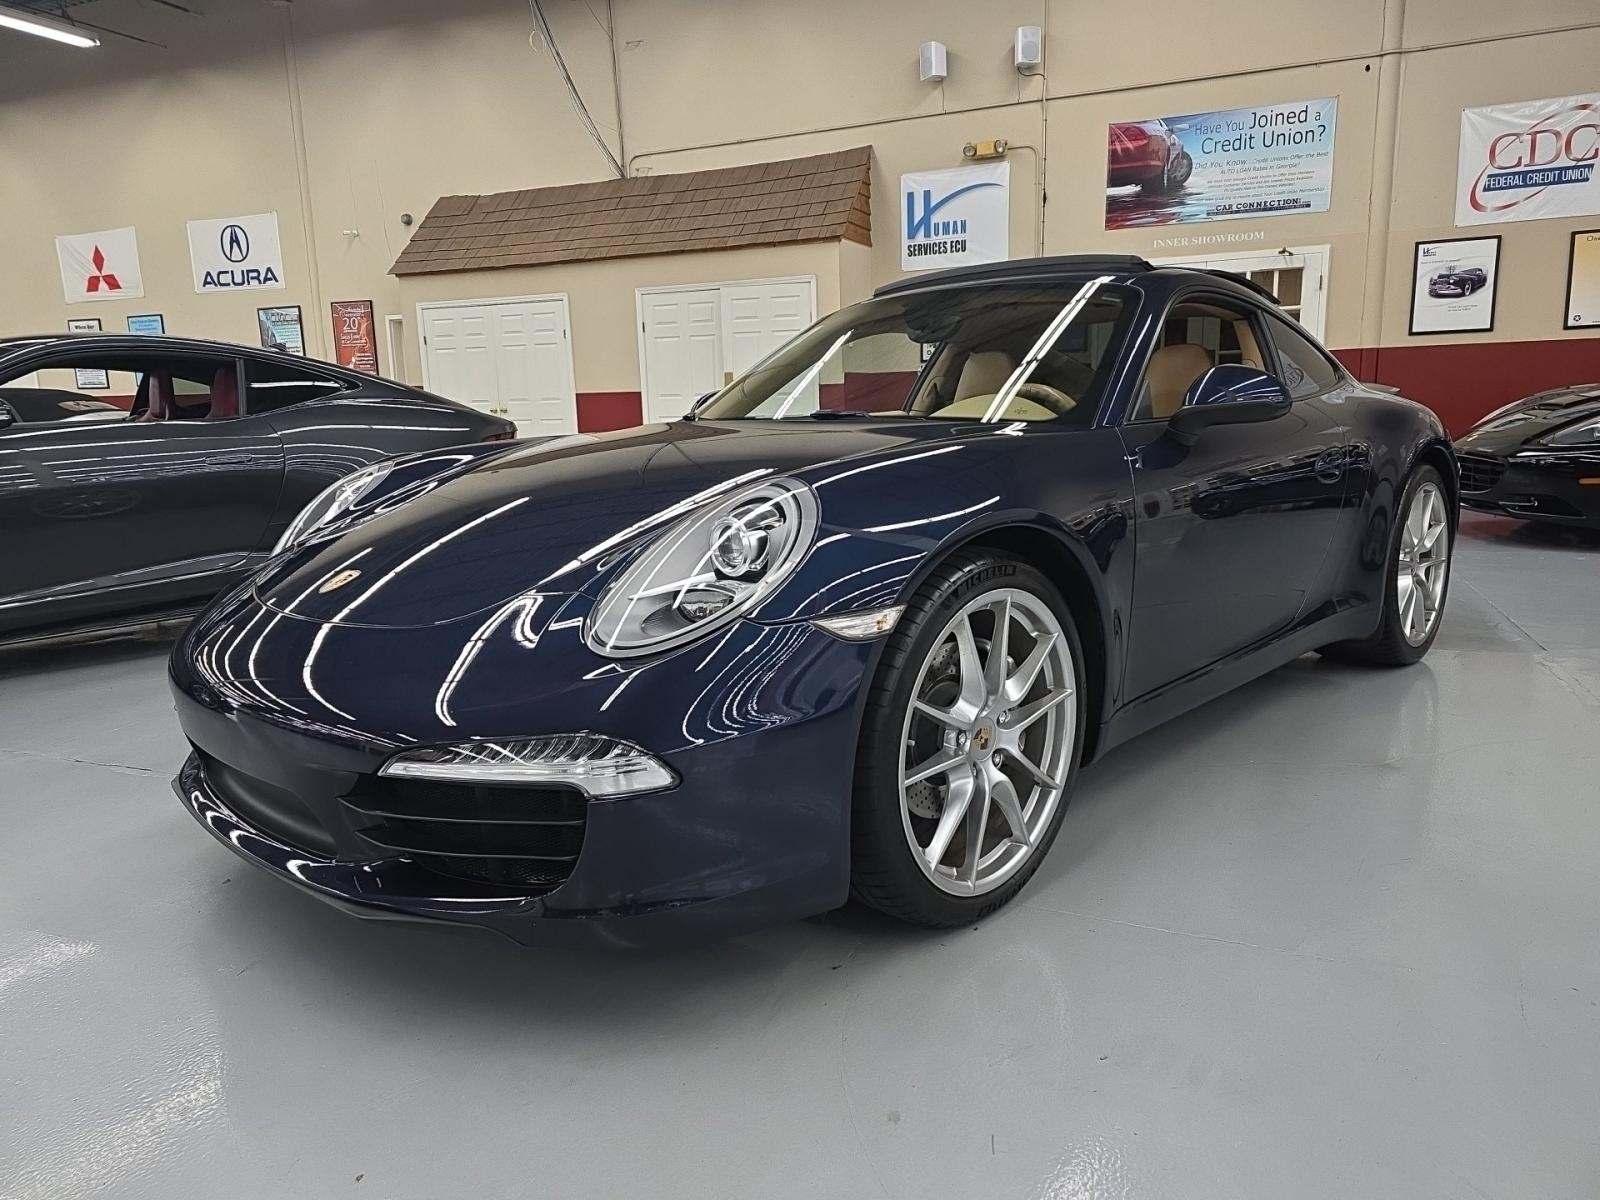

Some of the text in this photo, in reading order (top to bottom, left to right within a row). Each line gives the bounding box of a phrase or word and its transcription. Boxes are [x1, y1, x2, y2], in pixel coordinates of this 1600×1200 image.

[1194, 105, 1321, 135] Have You Joined a
[1201, 124, 1326, 154] Credit Union?
[1489, 123, 1600, 170] CDC
[1194, 162, 1208, 170] Did
[1485, 167, 1592, 188] FEDERAL CREDIT UNION
[1216, 203, 1234, 212] CAR
[1235, 197, 1299, 210] CONNECTION
[907, 239, 967, 258] SERVICES ECU
[1153, 231, 1265, 248] INNER SHOWROOM
[202, 266, 279, 288] ACURA
[343, 317, 358, 330] 20
